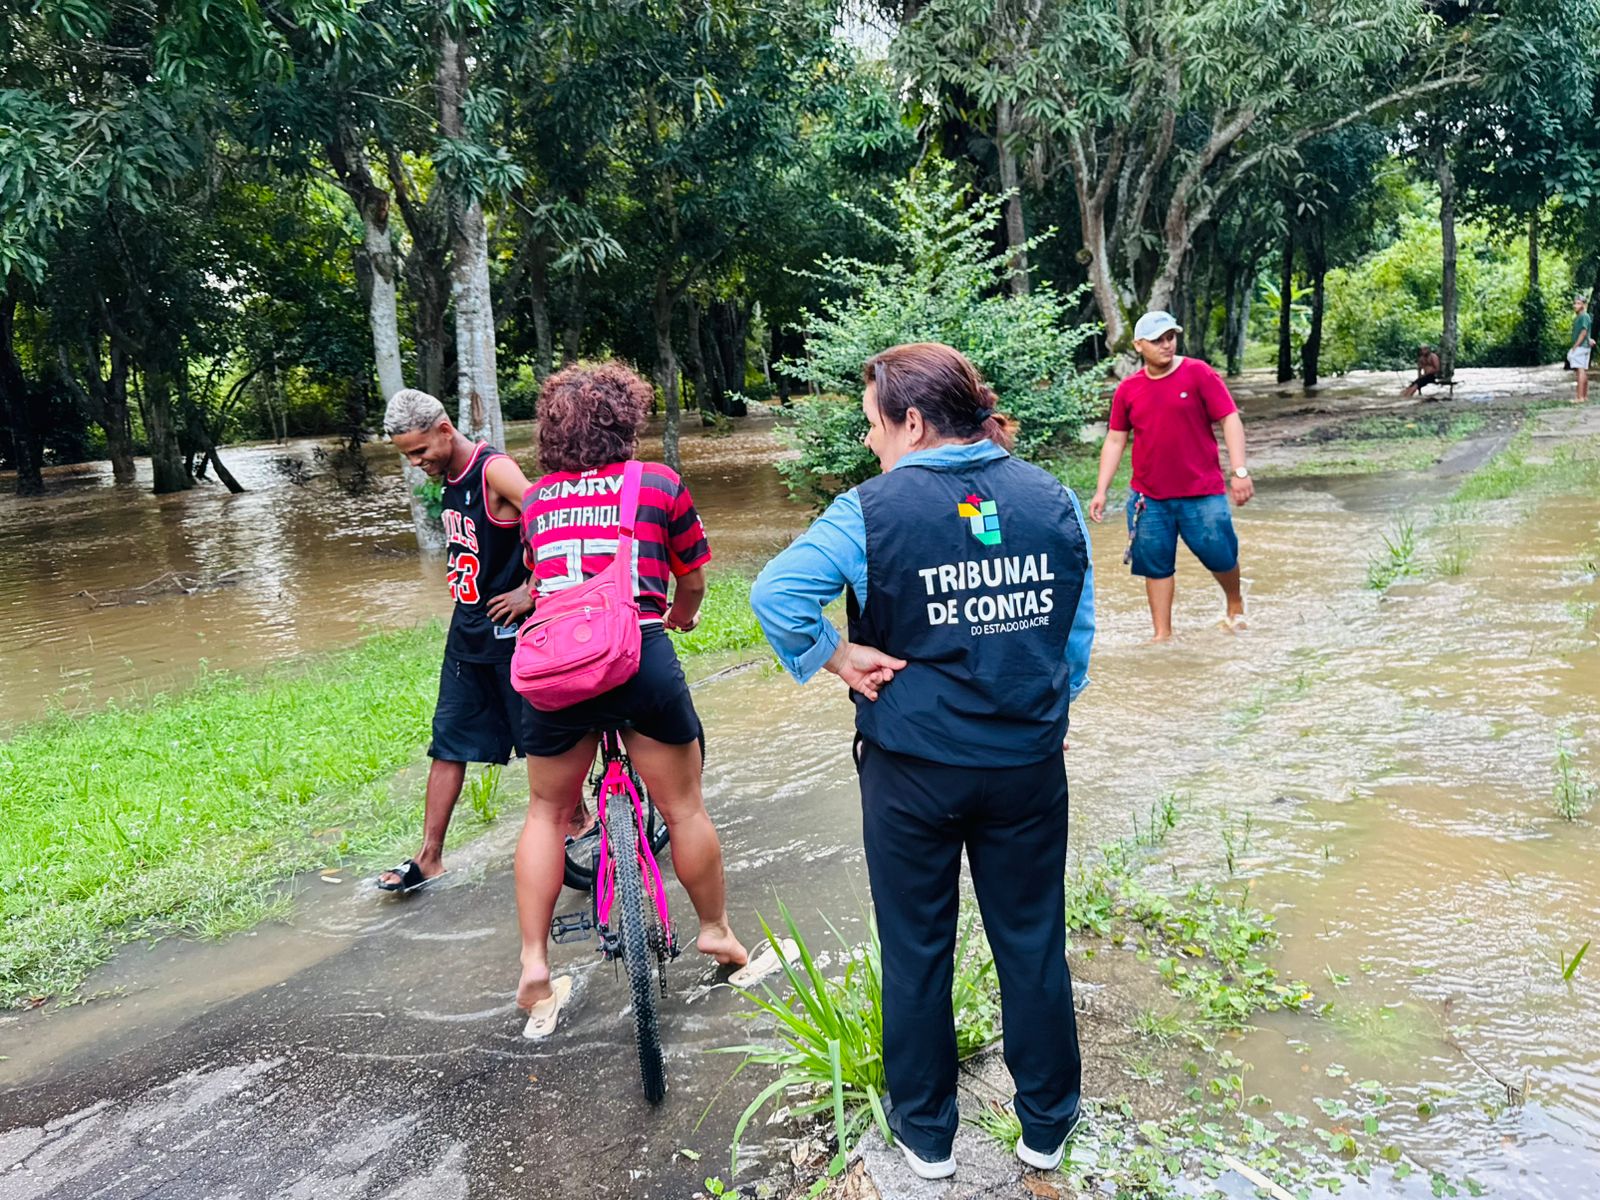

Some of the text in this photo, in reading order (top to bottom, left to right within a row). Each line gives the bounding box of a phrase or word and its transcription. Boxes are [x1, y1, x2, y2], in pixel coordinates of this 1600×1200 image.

[561, 475, 624, 498] MRV
[918, 553, 1055, 595] TRIBUNAL
[927, 588, 1054, 625] DE CONTAS
[970, 616, 1050, 636] DO ESTADO DO ACRE
